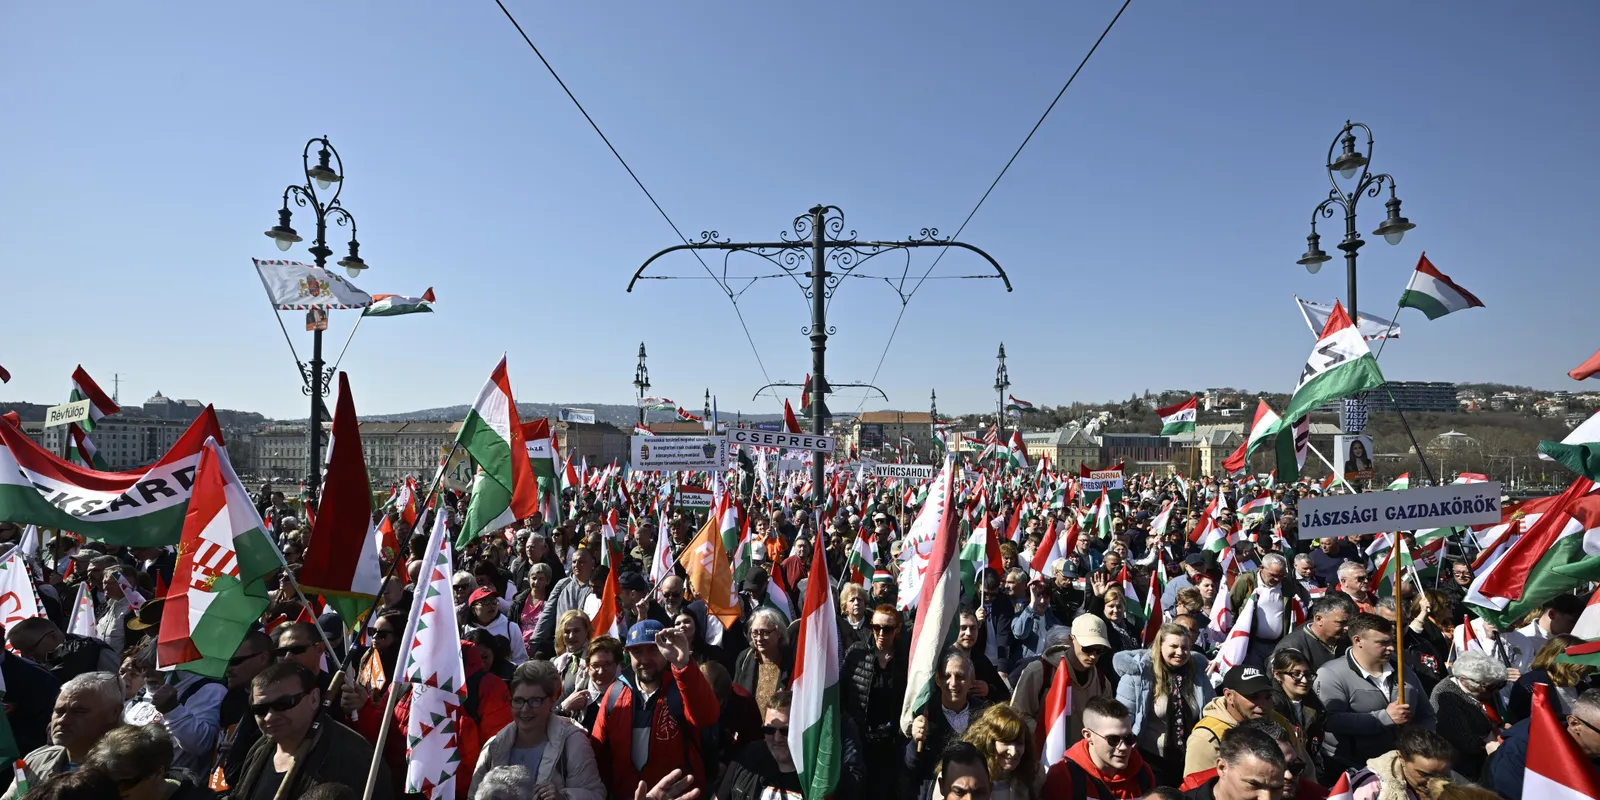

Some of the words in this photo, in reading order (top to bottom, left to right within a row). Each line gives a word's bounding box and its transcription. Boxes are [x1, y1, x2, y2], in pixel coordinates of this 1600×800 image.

[50, 405, 85, 422] Révfülöp
[735, 431, 827, 448] CSEPREG
[876, 464, 932, 478] NYÍRCSAHOLY
[1092, 472, 1120, 480] CSORNA
[1302, 506, 1378, 528] JÁSZSÁGI
[1385, 494, 1497, 520] GAZDAKÖRÖK
[1243, 667, 1260, 676] NIKE
